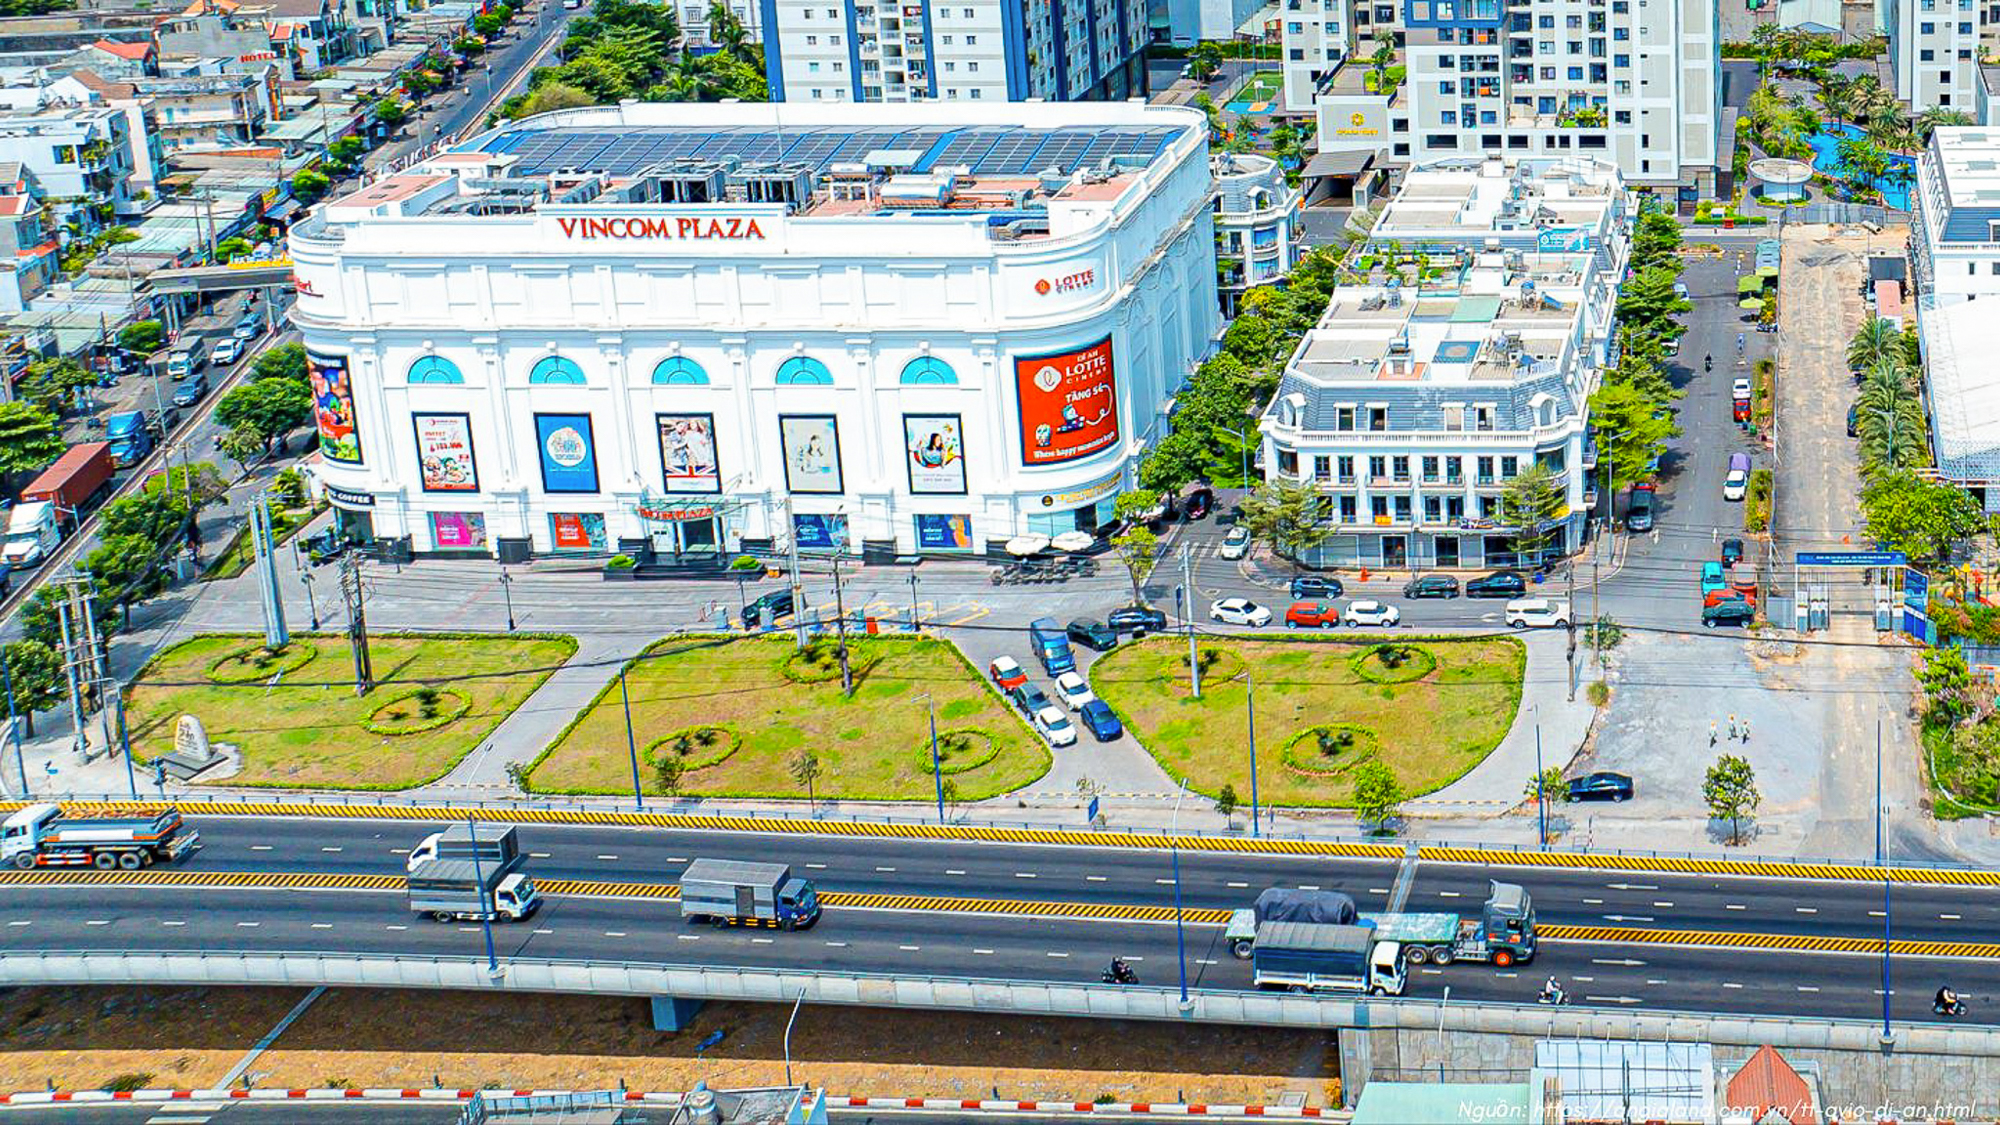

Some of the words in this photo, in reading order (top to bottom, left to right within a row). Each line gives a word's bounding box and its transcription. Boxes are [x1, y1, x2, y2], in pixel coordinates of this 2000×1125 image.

[240, 52, 275, 62] HOTEL
[557, 218, 671, 239] VINCOM
[676, 218, 765, 239] PLAZA
[1055, 269, 1094, 287] LOTTE
[1066, 355, 1106, 377] LOTTE
[1056, 446, 1076, 457] happy
[338, 493, 370, 504] COFFEE
